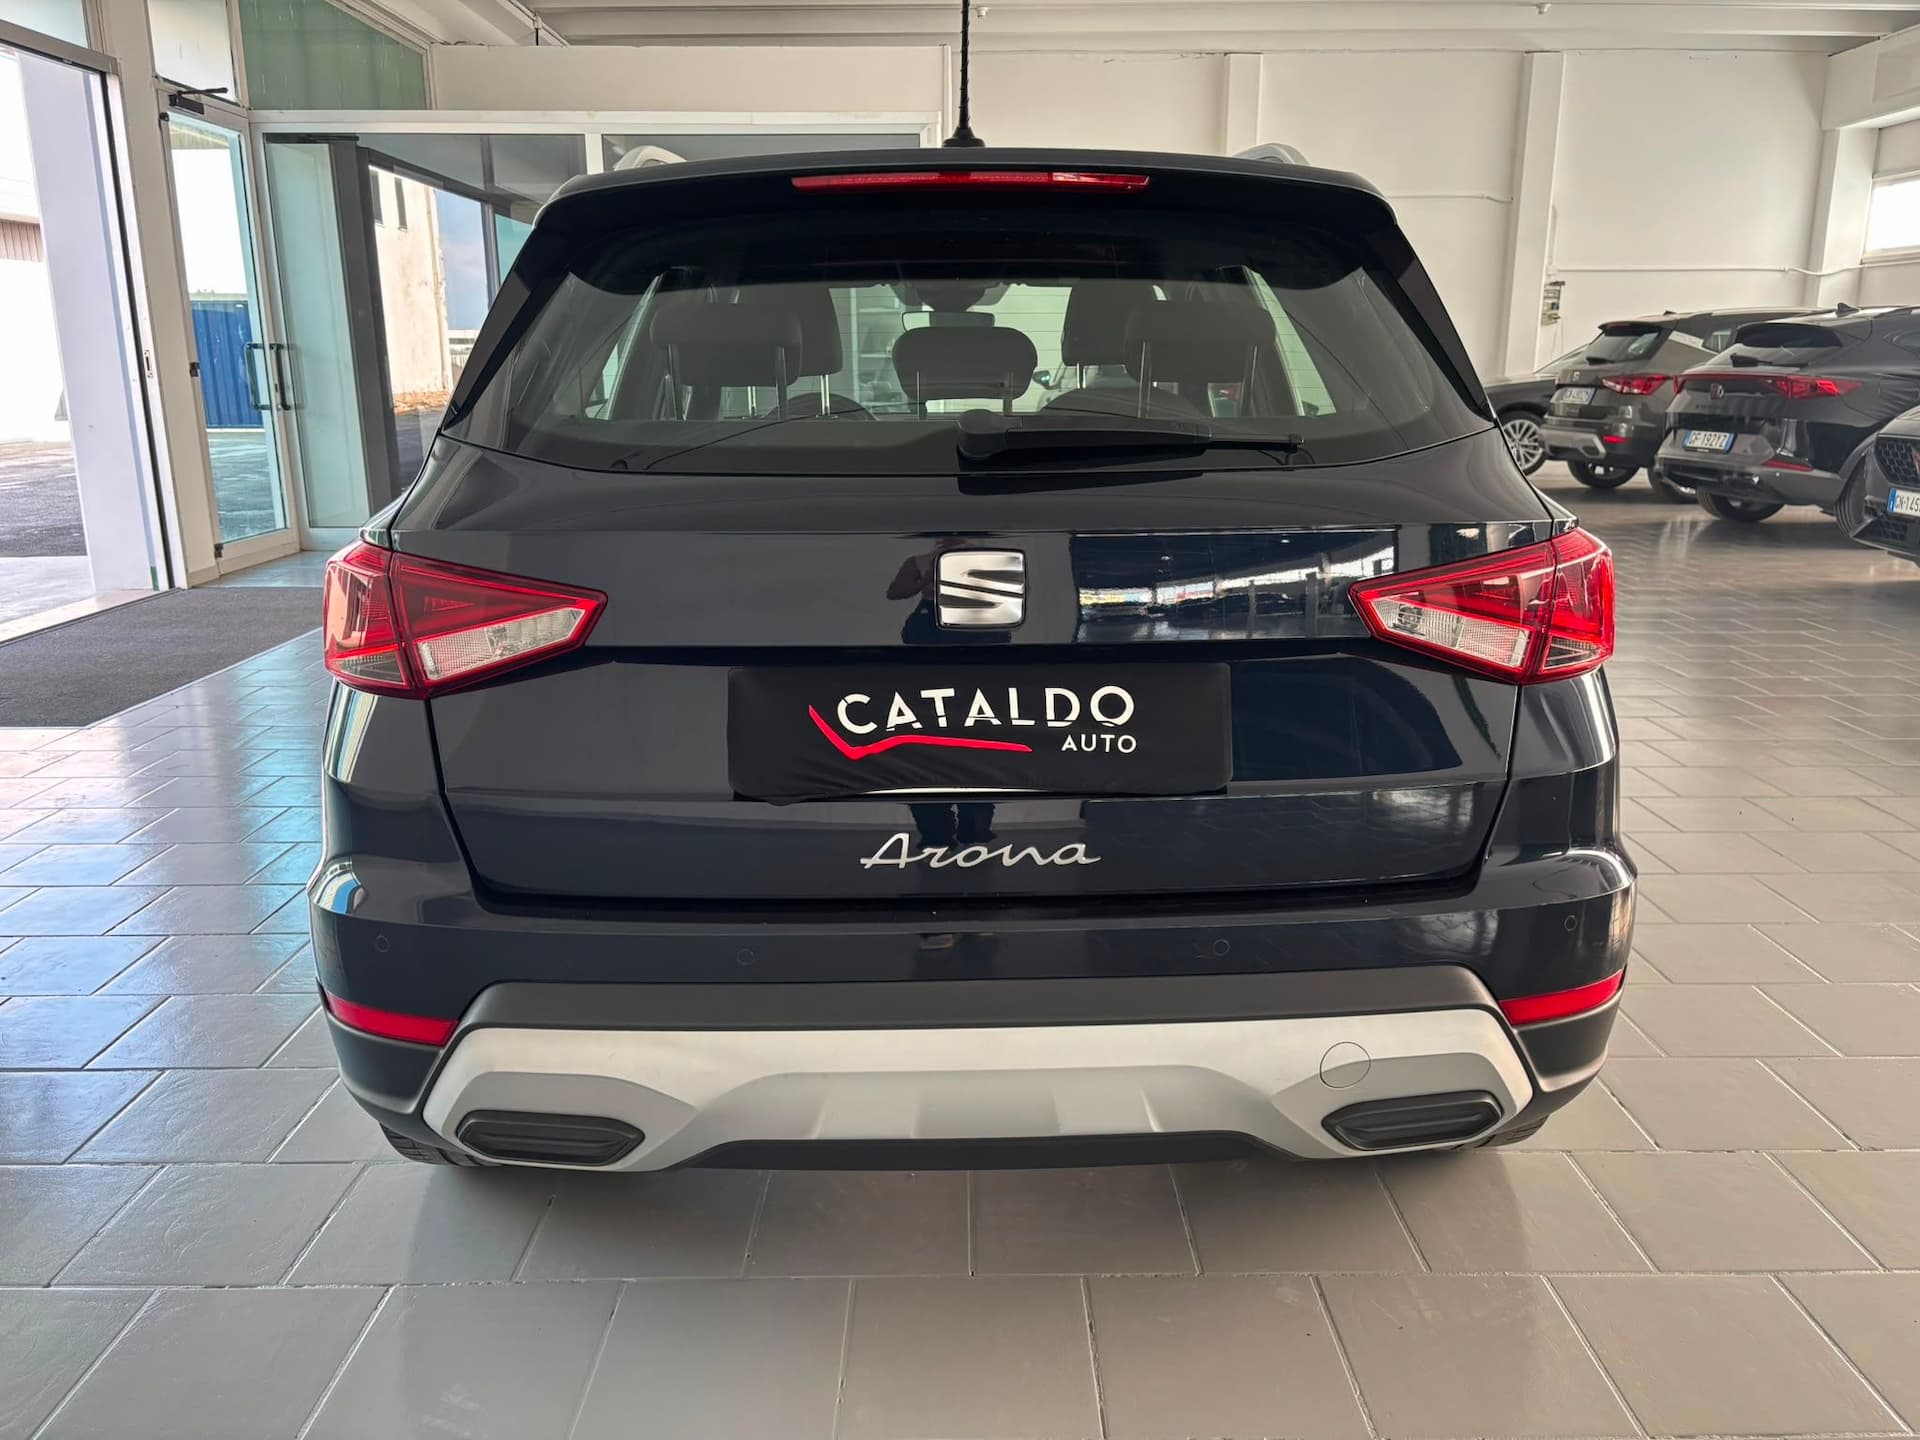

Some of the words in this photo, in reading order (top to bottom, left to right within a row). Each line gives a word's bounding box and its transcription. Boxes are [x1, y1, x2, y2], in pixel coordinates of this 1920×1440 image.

[837, 685, 1135, 735] CATALDO
[1061, 733, 1138, 754] AUTO
[859, 832, 1101, 869] Arona
